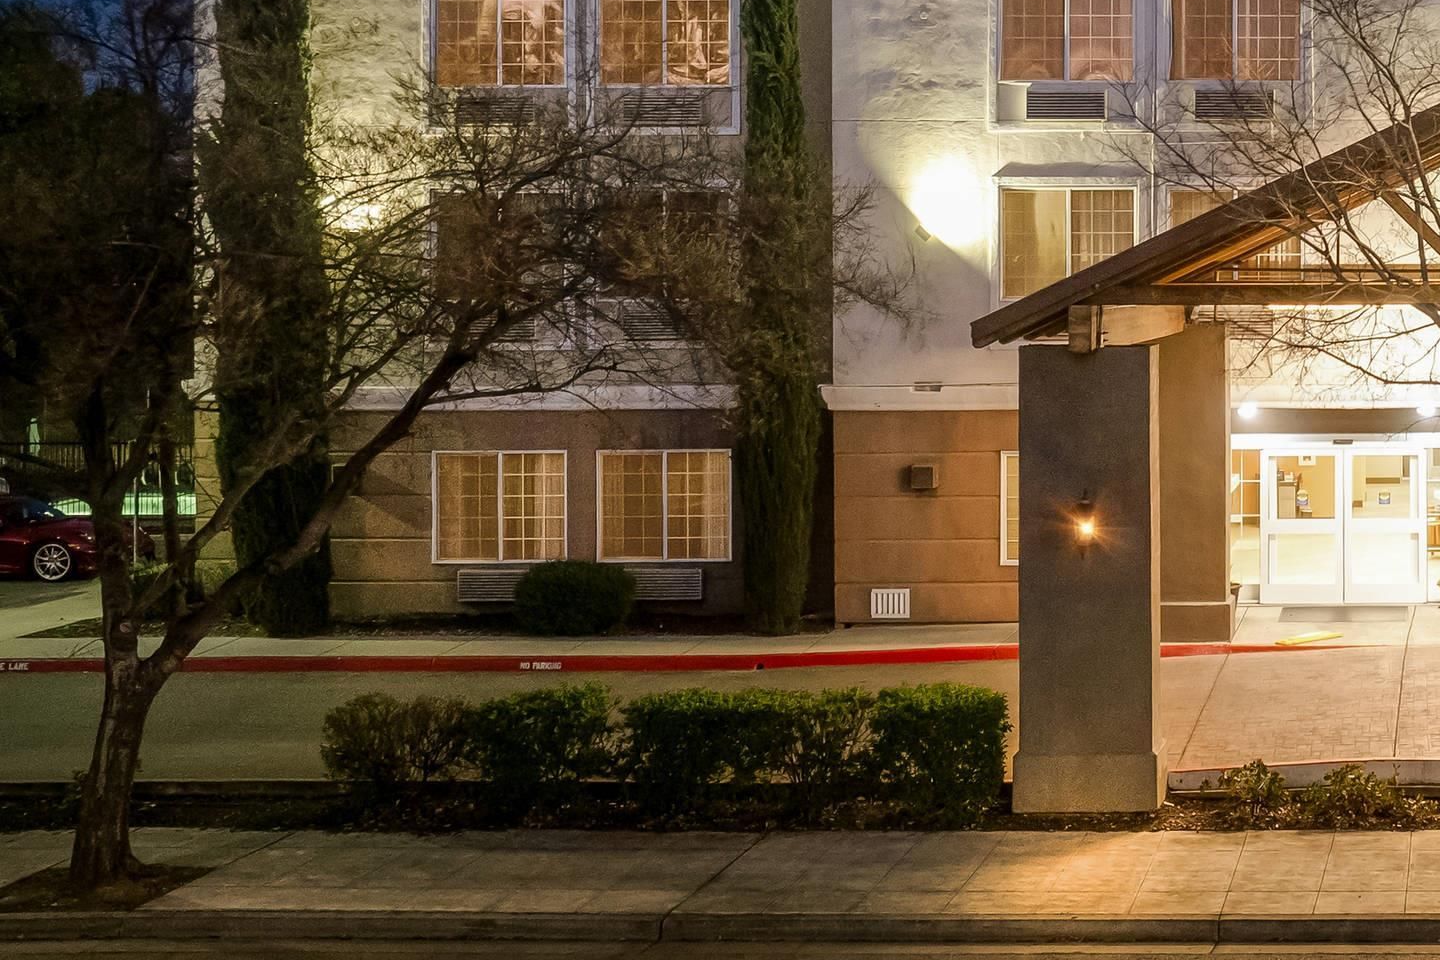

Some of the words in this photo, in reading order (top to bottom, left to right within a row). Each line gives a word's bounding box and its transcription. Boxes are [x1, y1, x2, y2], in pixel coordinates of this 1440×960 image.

[8, 662, 30, 671] LANE
[520, 662, 531, 670] NO
[532, 662, 562, 670] PARKING
